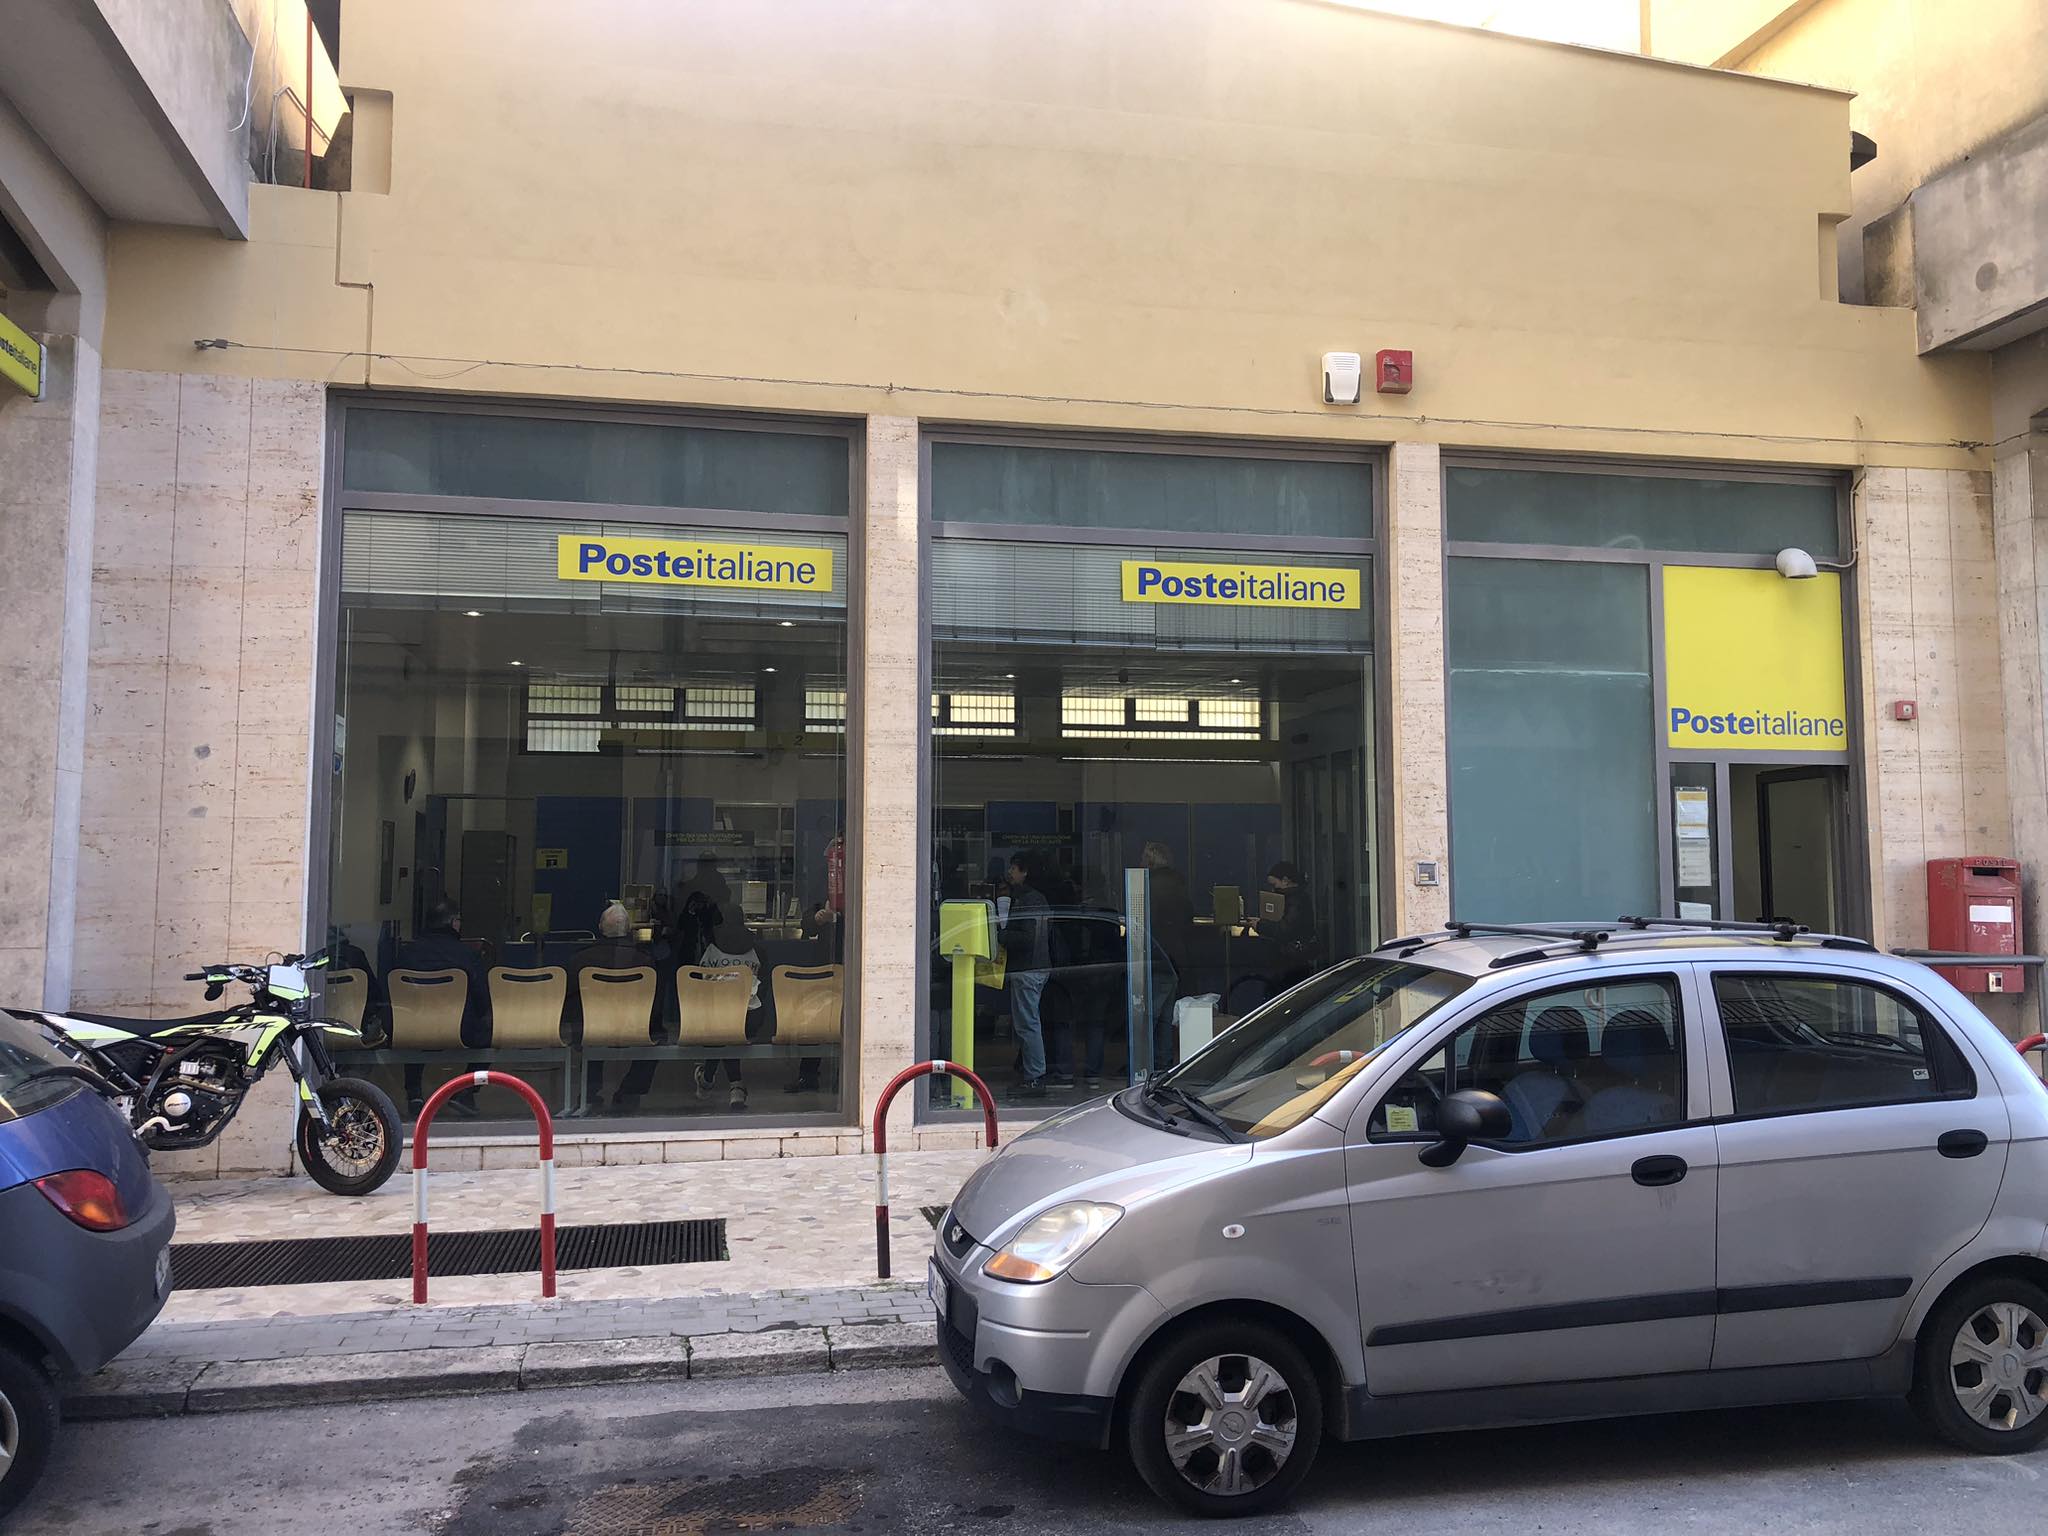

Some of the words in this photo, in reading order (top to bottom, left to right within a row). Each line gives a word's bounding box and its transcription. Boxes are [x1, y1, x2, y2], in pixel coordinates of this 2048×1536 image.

[579, 542, 816, 585] Posteitaliane
[1137, 567, 1346, 603] Posteitaliane
[1671, 707, 1845, 737] Posteitaliane
